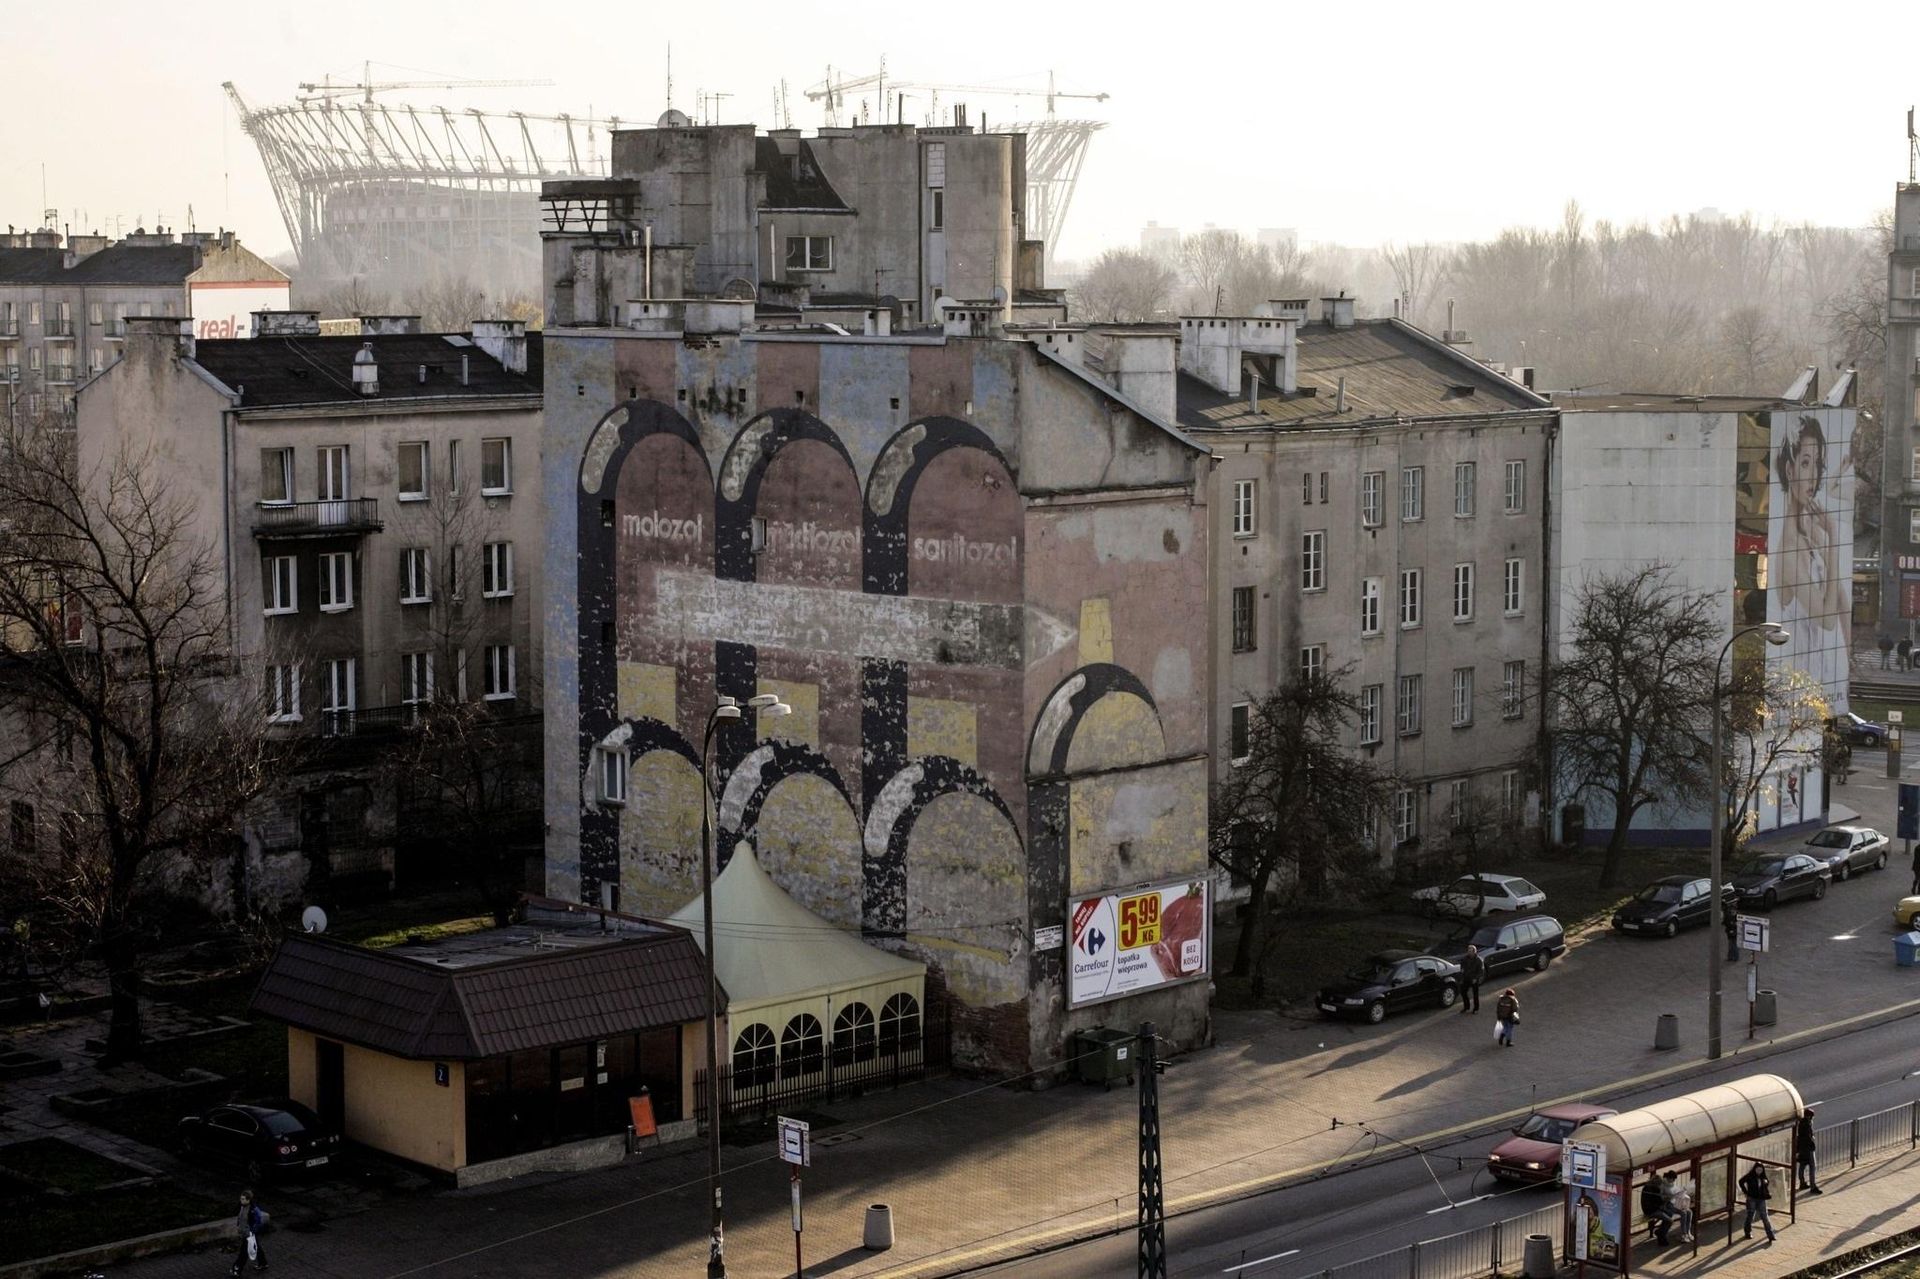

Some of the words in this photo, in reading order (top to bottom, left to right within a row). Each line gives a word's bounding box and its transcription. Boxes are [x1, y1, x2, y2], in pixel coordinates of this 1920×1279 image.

[1143, 929, 1154, 943] KG
[1186, 944, 1196, 955] BEZ
[1074, 959, 1109, 974] Carrefour
